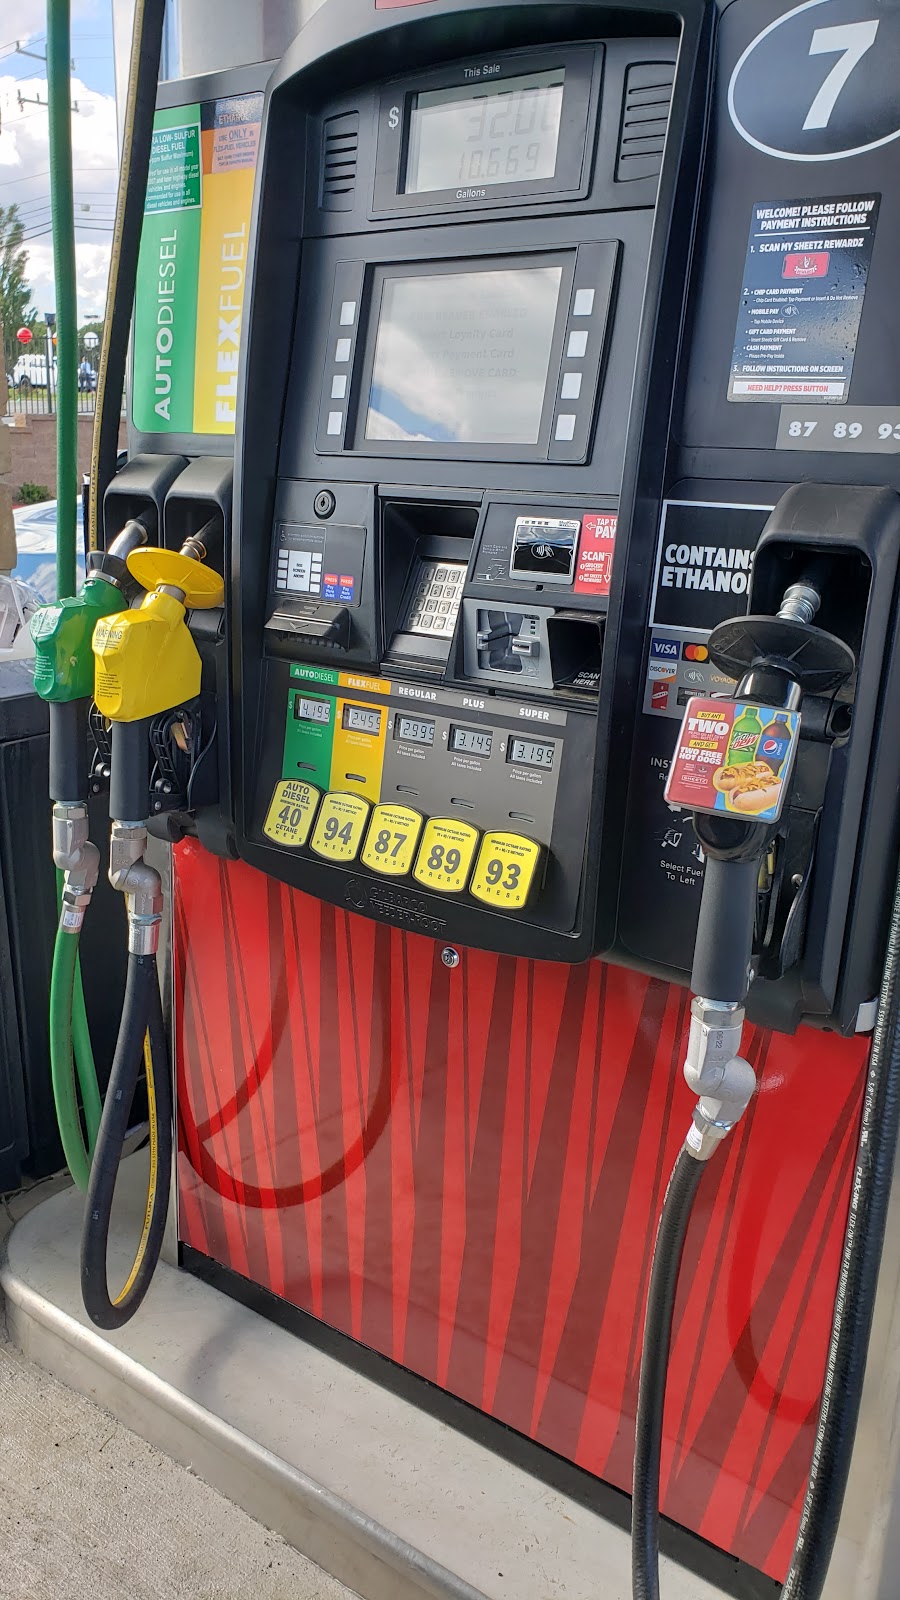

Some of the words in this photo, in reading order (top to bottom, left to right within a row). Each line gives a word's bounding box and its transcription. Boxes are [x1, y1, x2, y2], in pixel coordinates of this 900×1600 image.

[464, 66, 480, 78] This
[483, 64, 500, 75] Sale
[802, 20, 880, 130] 7
[388, 105, 399, 130] $
[174, 130, 196, 140] SULFUR
[229, 128, 247, 140] ONLY
[172, 142, 185, 150] FUEL
[456, 189, 486, 199] Gallons
[756, 205, 801, 220] WELCOME!
[802, 203, 835, 216] PLEASE
[836, 200, 875, 213] FOLLOW
[760, 218, 800, 230] PAYMENT
[801, 213, 867, 228] INSTRUCTIONS
[759, 243, 781, 253] SCAN
[781, 242, 793, 251] MY
[794, 240, 823, 250] SHEETZ
[824, 238, 864, 249] REWARDZ
[154, 229, 177, 421] AUTODIESEL
[215, 222, 246, 423] FLEXFUEL
[766, 365, 809, 373] INSTRUCTIONS
[788, 421, 818, 437] 87
[833, 422, 863, 438] 89
[597, 518, 610, 526] TAP
[594, 525, 617, 539] PAY
[581, 551, 605, 562] SCAN
[96, 629, 122, 640] WARNING
[653, 642, 677, 655] VISA
[294, 668, 334, 683] AUTODIESEL
[578, 671, 600, 680] SCAN
[649, 665, 676, 674] DISCOVER
[347, 677, 381, 691] FLEXFUEL
[573, 678, 595, 686] HERE
[710, 676, 738, 685] VOYAGE
[398, 686, 437, 701] REGULAR
[462, 697, 485, 709] PLUS
[519, 707, 550, 721] SUPER
[387, 720, 393, 730] $
[688, 717, 729, 736] TWO
[441, 731, 447, 741] $
[500, 742, 505, 752] $
[680, 746, 699, 756] TWO
[700, 749, 723, 759] FREE
[679, 752, 696, 761] HOT
[697, 755, 722, 765] DOGS
[285, 781, 310, 794] AUTO
[282, 789, 311, 805] DIESEL
[278, 805, 302, 828] 40
[275, 822, 298, 835] CETANE
[323, 817, 354, 845] 94
[374, 829, 408, 858] 87
[427, 844, 461, 875] 89
[485, 858, 521, 890] 93
[660, 860, 684, 873] Select
[686, 866, 703, 877] Fuel
[666, 871, 676, 881] To
[680, 875, 696, 886] Left
[476, 884, 520, 901] PRESS
[887, 922, 898, 953] FRANKLIN
[883, 953, 894, 981] FUELING
[880, 980, 890, 1007] SYSTEMS
[873, 1026, 882, 1045] MADE
[872, 1045, 880, 1053] IN
[871, 1053, 879, 1066] USA
[838, 1269, 849, 1298] PREMIUM
[836, 1297, 845, 1313] FUEL
[833, 1313, 842, 1331] HOSE
[828, 1340, 839, 1370] FRANKLIN
[824, 1369, 835, 1397] FUELING
